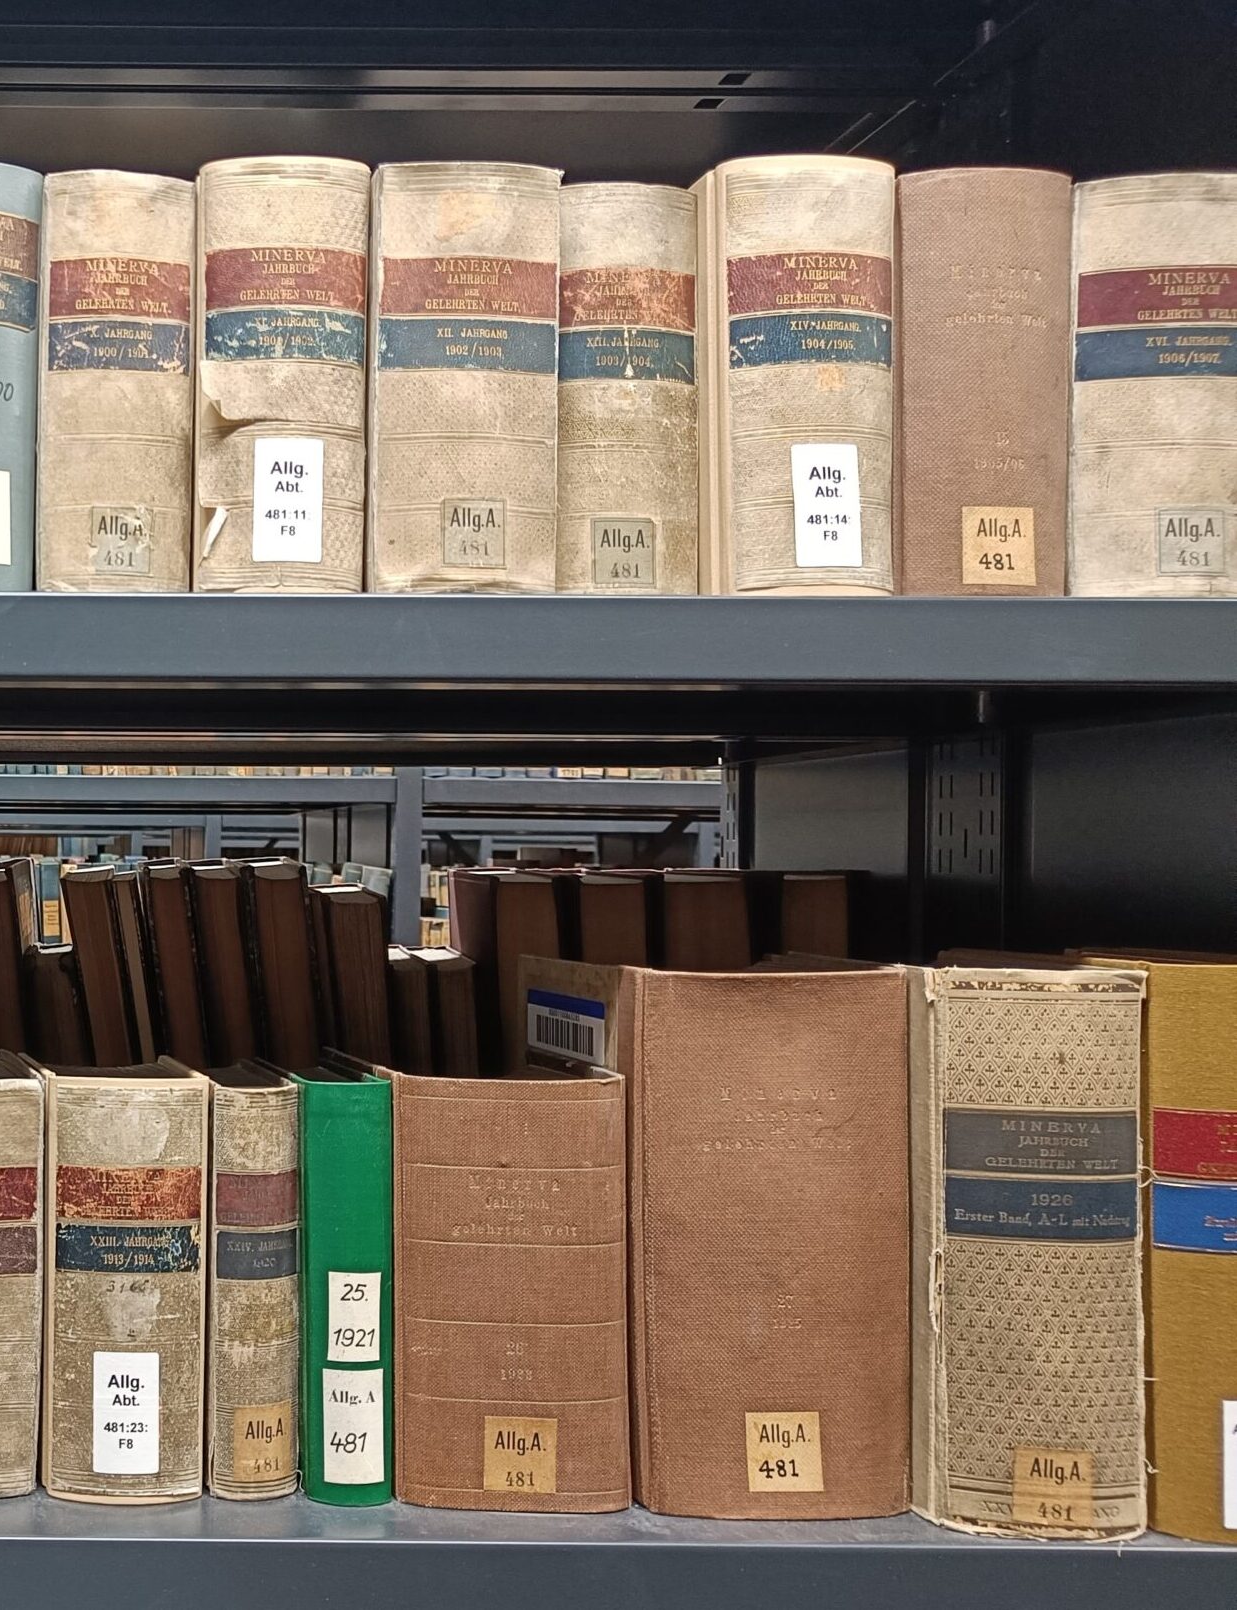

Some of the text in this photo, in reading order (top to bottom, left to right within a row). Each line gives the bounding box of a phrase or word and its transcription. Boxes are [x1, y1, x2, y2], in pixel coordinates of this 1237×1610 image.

[250, 248, 327, 264] MINERVA
[783, 256, 860, 271] MINERVA
[85, 260, 159, 275] MINERVA
[262, 263, 316, 275] JAHRBUCH
[433, 260, 514, 276] MINERVA
[95, 273, 149, 286] JAHRBUCH
[446, 273, 500, 286] JAHRBUCH
[795, 269, 848, 282] JAHRBUCH
[1148, 272, 1232, 287] MINERVA
[464, 288, 480, 296] DER
[813, 282, 829, 290] DER
[1162, 285, 1221, 297] JAHRBUCH
[239, 289, 300, 302] GELEHRTEN
[776, 293, 838, 306] GELEHRTEN
[1181, 298, 1200, 306] DER
[141, 301, 173, 315] WELT.
[425, 300, 522, 314] GELEHRTEN WELT.
[460, 328, 509, 341] JAHRGANG
[269, 461, 309, 478] Allg.
[808, 466, 847, 483] Allg.
[274, 480, 304, 494] Abt.
[815, 486, 844, 499] Abt.
[449, 507, 501, 533] Allg.A.
[97, 515, 148, 541] Allg.A.
[280, 525, 296, 536] F8
[976, 518, 1027, 542] Allg.A.
[1164, 517, 1221, 543] Allg.A.
[599, 528, 650, 553] Allg.A.
[823, 531, 839, 542] F8
[103, 550, 137, 568] 481
[978, 553, 1016, 571] 481
[1176, 551, 1211, 568] 481
[610, 563, 643, 579] 481
[1001, 1119, 1102, 1134] MINERVA
[1017, 1136, 1090, 1148] JAHRBUCH
[984, 1156, 1120, 1170] GELEHRTEN WELT
[1031, 1194, 1074, 1207] 1926
[954, 1208, 995, 1223] Erster
[1038, 1213, 1069, 1226] A-L
[340, 1283, 369, 1302] 25.
[333, 1328, 376, 1348] 1921
[107, 1375, 146, 1392] Allg.
[111, 1394, 141, 1407] Abt.
[328, 1390, 376, 1406] Allg. A
[103, 1422, 148, 1434] 481:23:
[758, 1423, 812, 1448] Allg.A.
[118, 1439, 134, 1450] F8
[329, 1432, 368, 1453] 481
[494, 1430, 547, 1456] Allg.A.
[253, 1457, 281, 1474] 481
[758, 1459, 800, 1478] 481
[1030, 1457, 1087, 1485] Allg.A.
[505, 1471, 535, 1487] 481
[1037, 1503, 1075, 1522] 481
